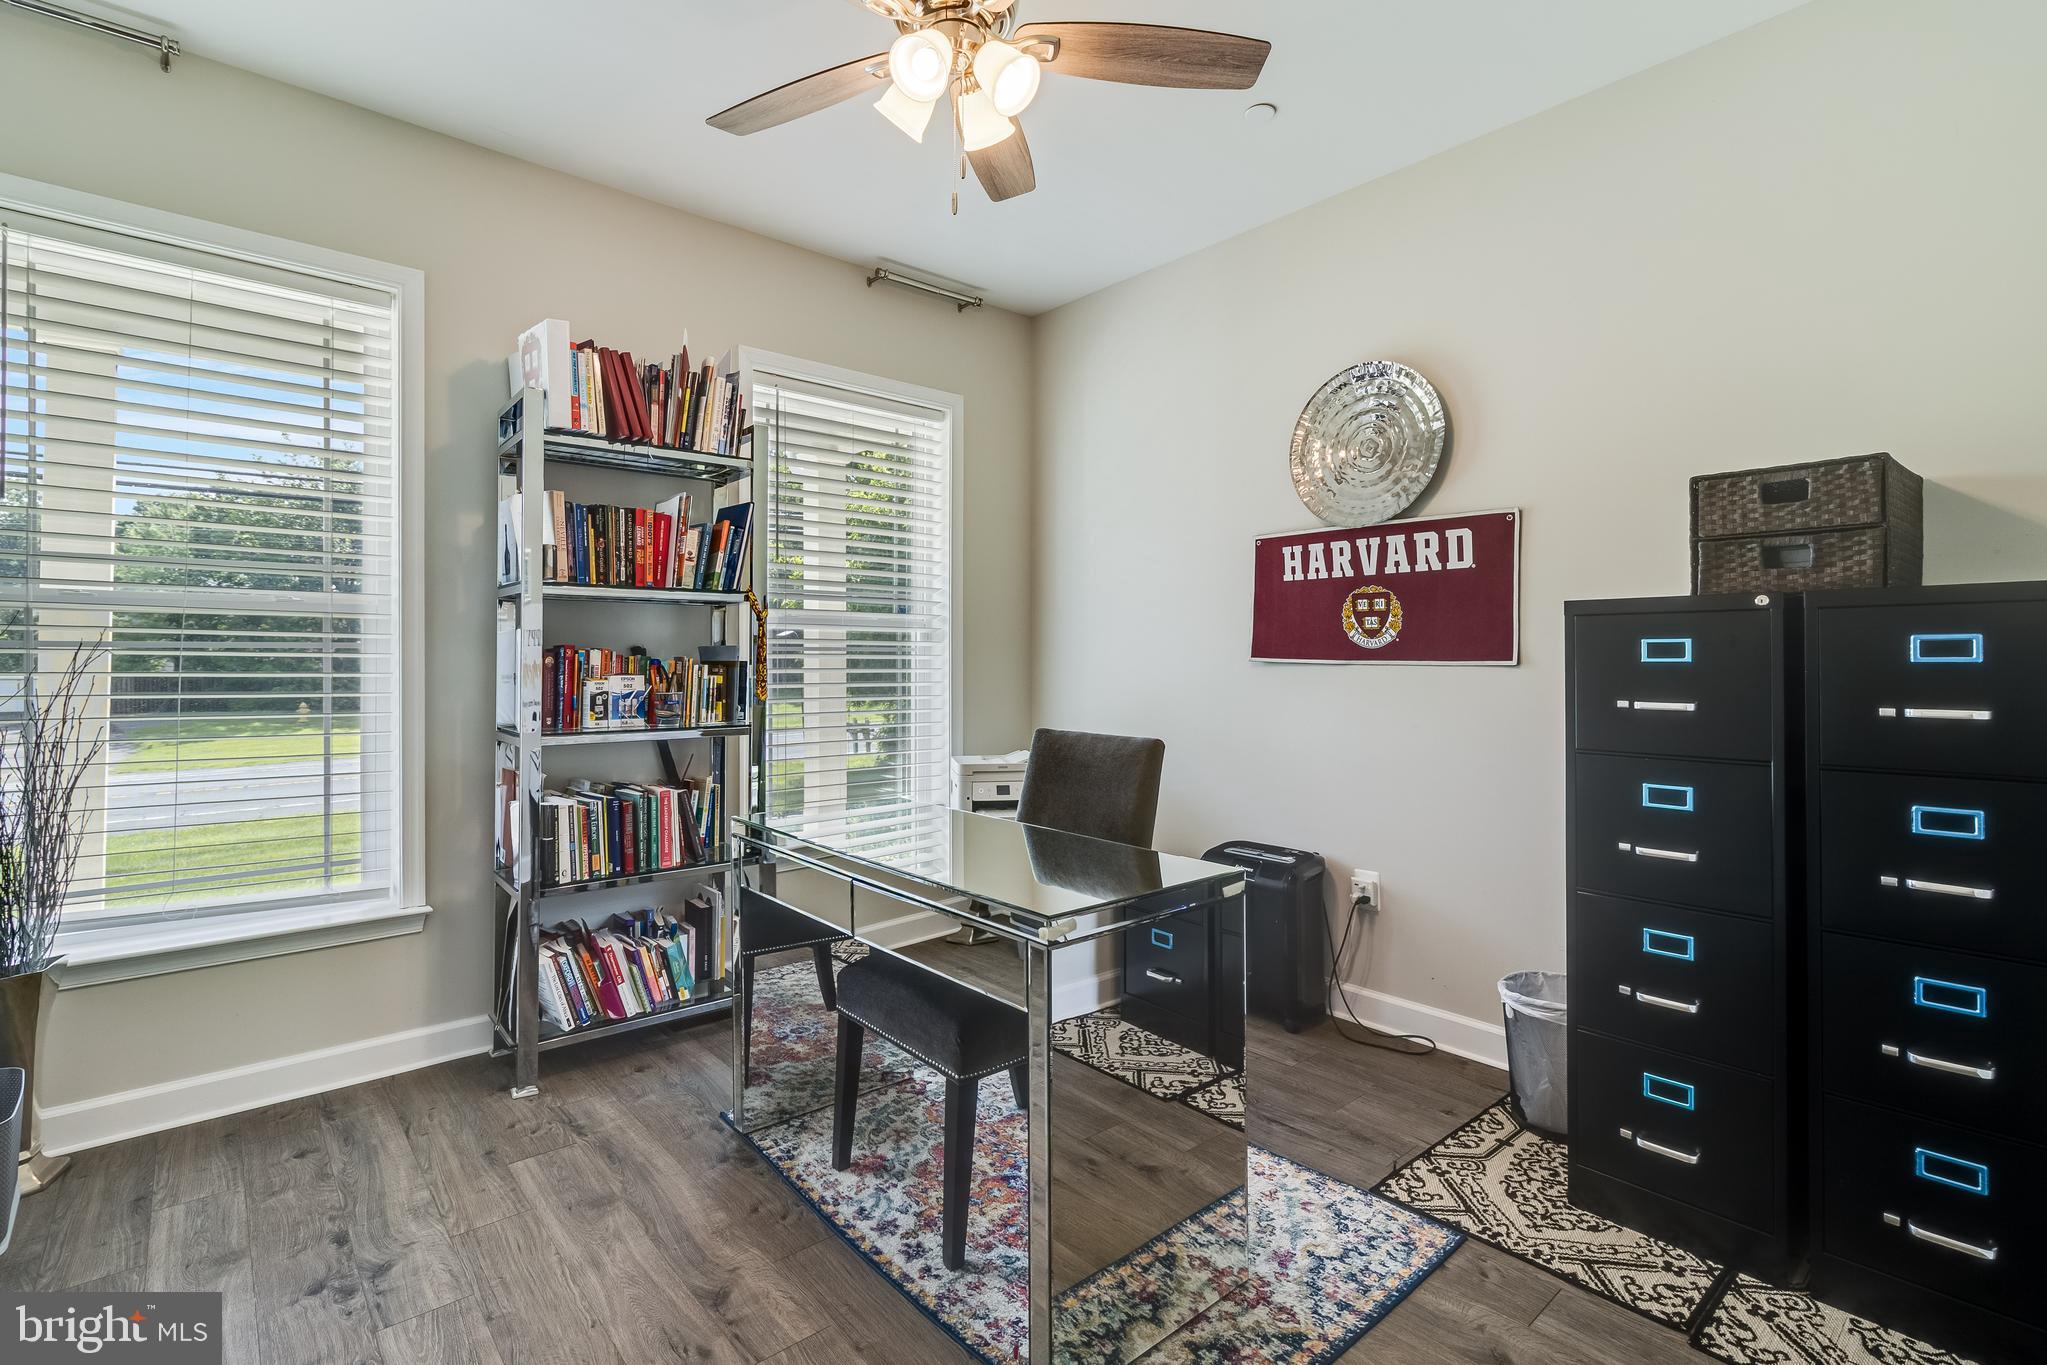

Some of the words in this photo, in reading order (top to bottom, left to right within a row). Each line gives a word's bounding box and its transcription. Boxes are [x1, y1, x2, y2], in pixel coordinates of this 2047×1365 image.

[559, 520, 567, 551] NEVILLE
[1282, 528, 1473, 582] HARVARD
[1356, 636, 1388, 646] HARVARD
[553, 983, 561, 992] Lost
[555, 991, 563, 1002] Cities
[561, 1006, 569, 1018] Africa
